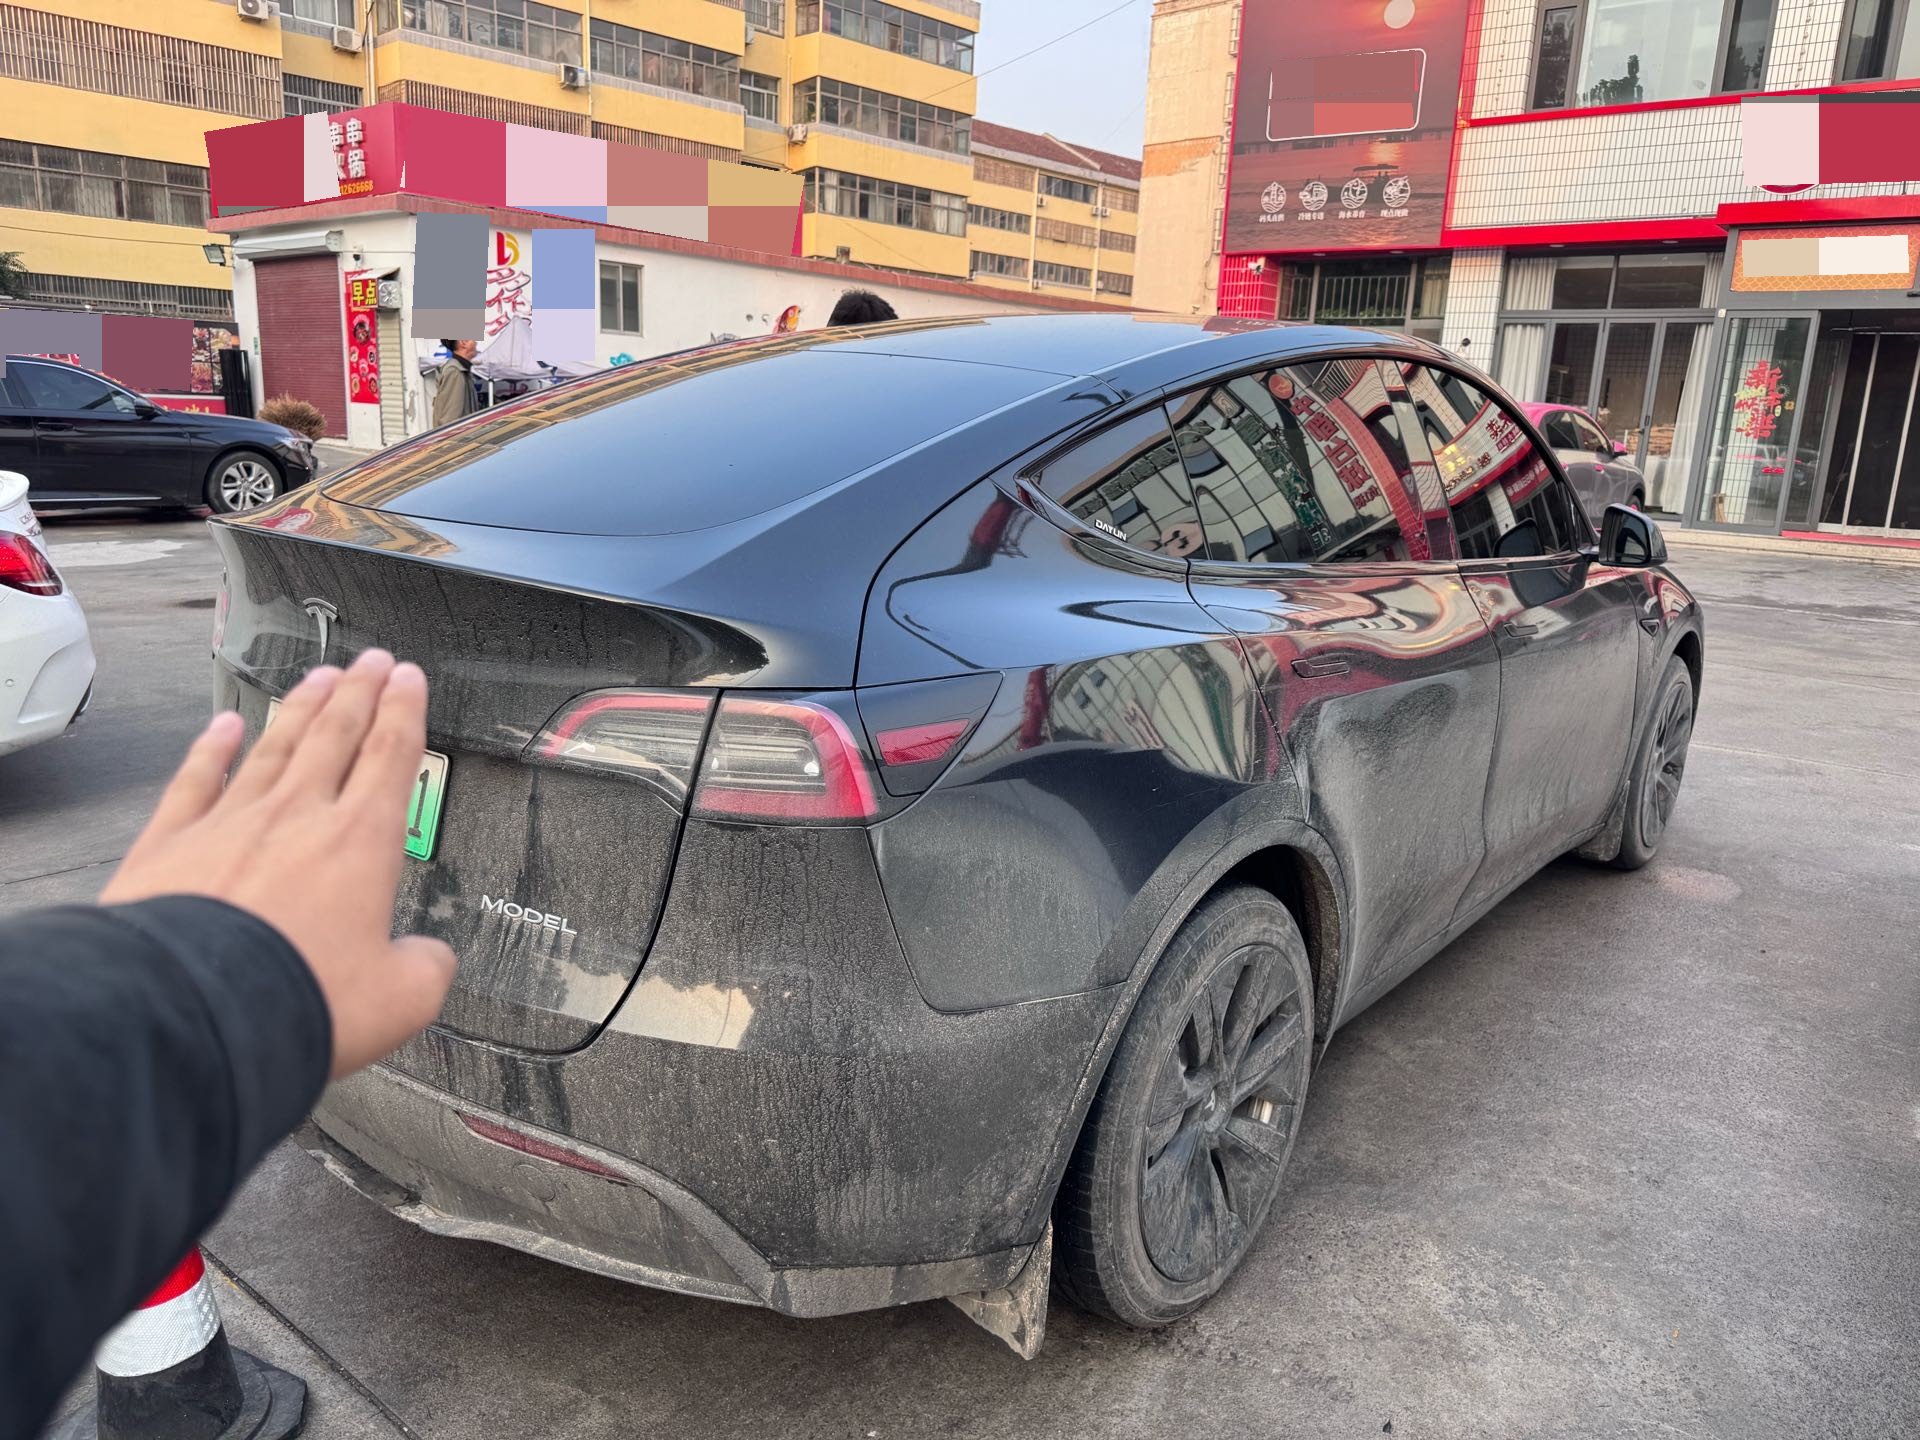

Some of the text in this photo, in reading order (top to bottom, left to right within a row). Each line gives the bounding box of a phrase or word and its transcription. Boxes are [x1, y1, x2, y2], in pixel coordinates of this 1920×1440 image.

[352, 280, 377, 306] 早点
[1095, 519, 1128, 541] DAYUN
[481, 894, 578, 935] MODEL
